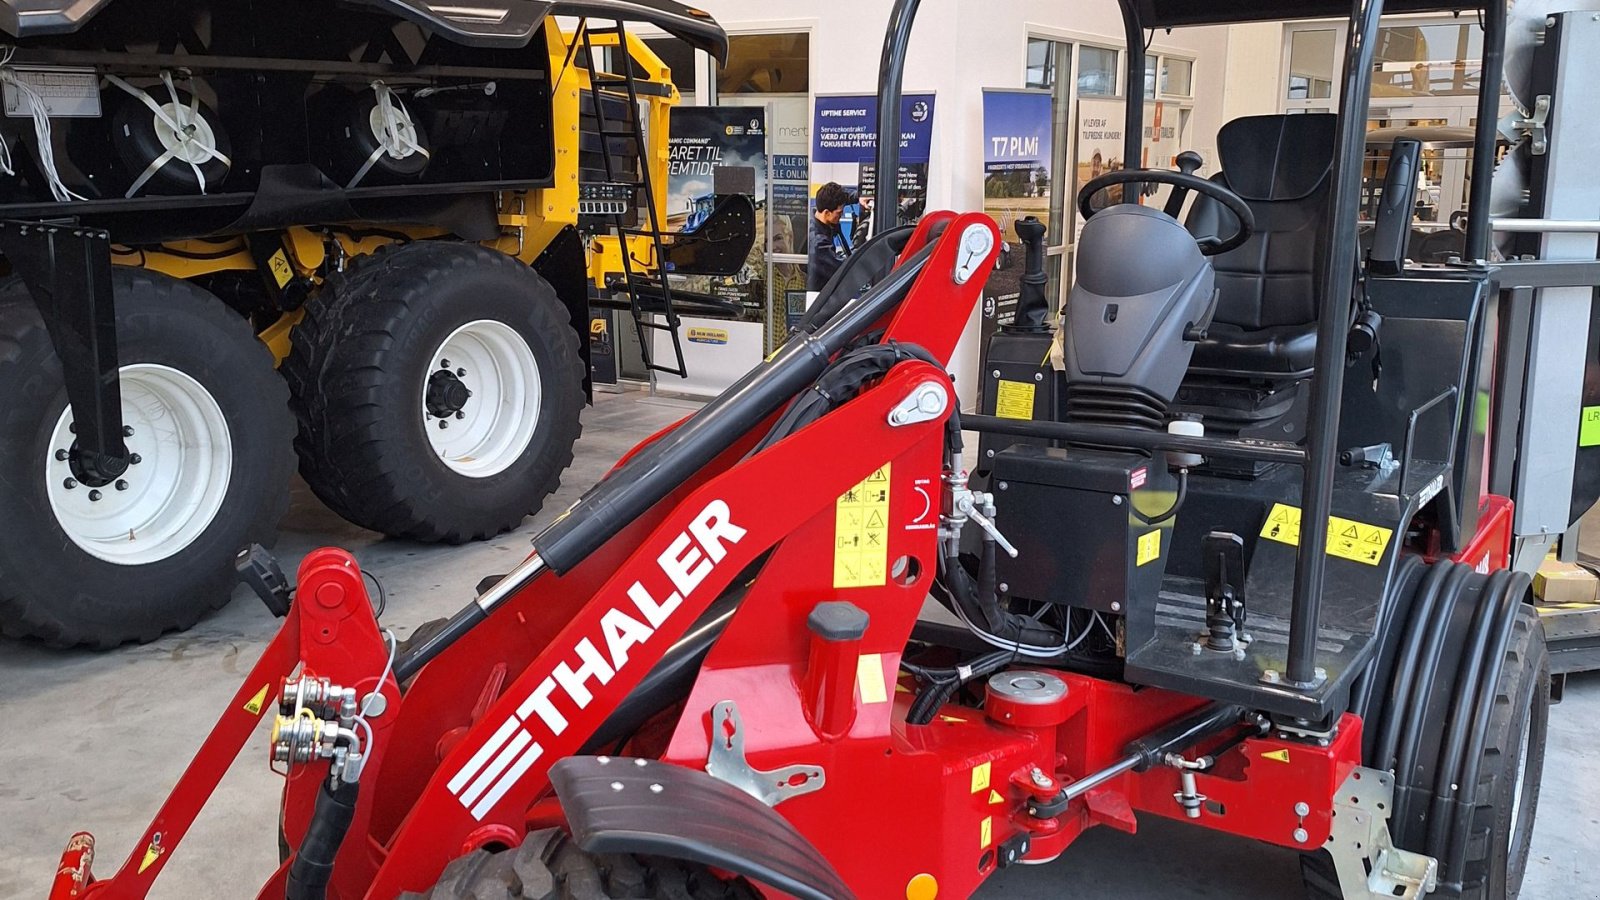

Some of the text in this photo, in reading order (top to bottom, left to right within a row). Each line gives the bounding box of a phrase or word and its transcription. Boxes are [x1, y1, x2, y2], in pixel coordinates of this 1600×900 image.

[820, 109, 842, 117] UPTIME
[991, 136, 1039, 156] T7 PLMi
[706, 146, 722, 160] TIL
[779, 157, 796, 166] ALLE
